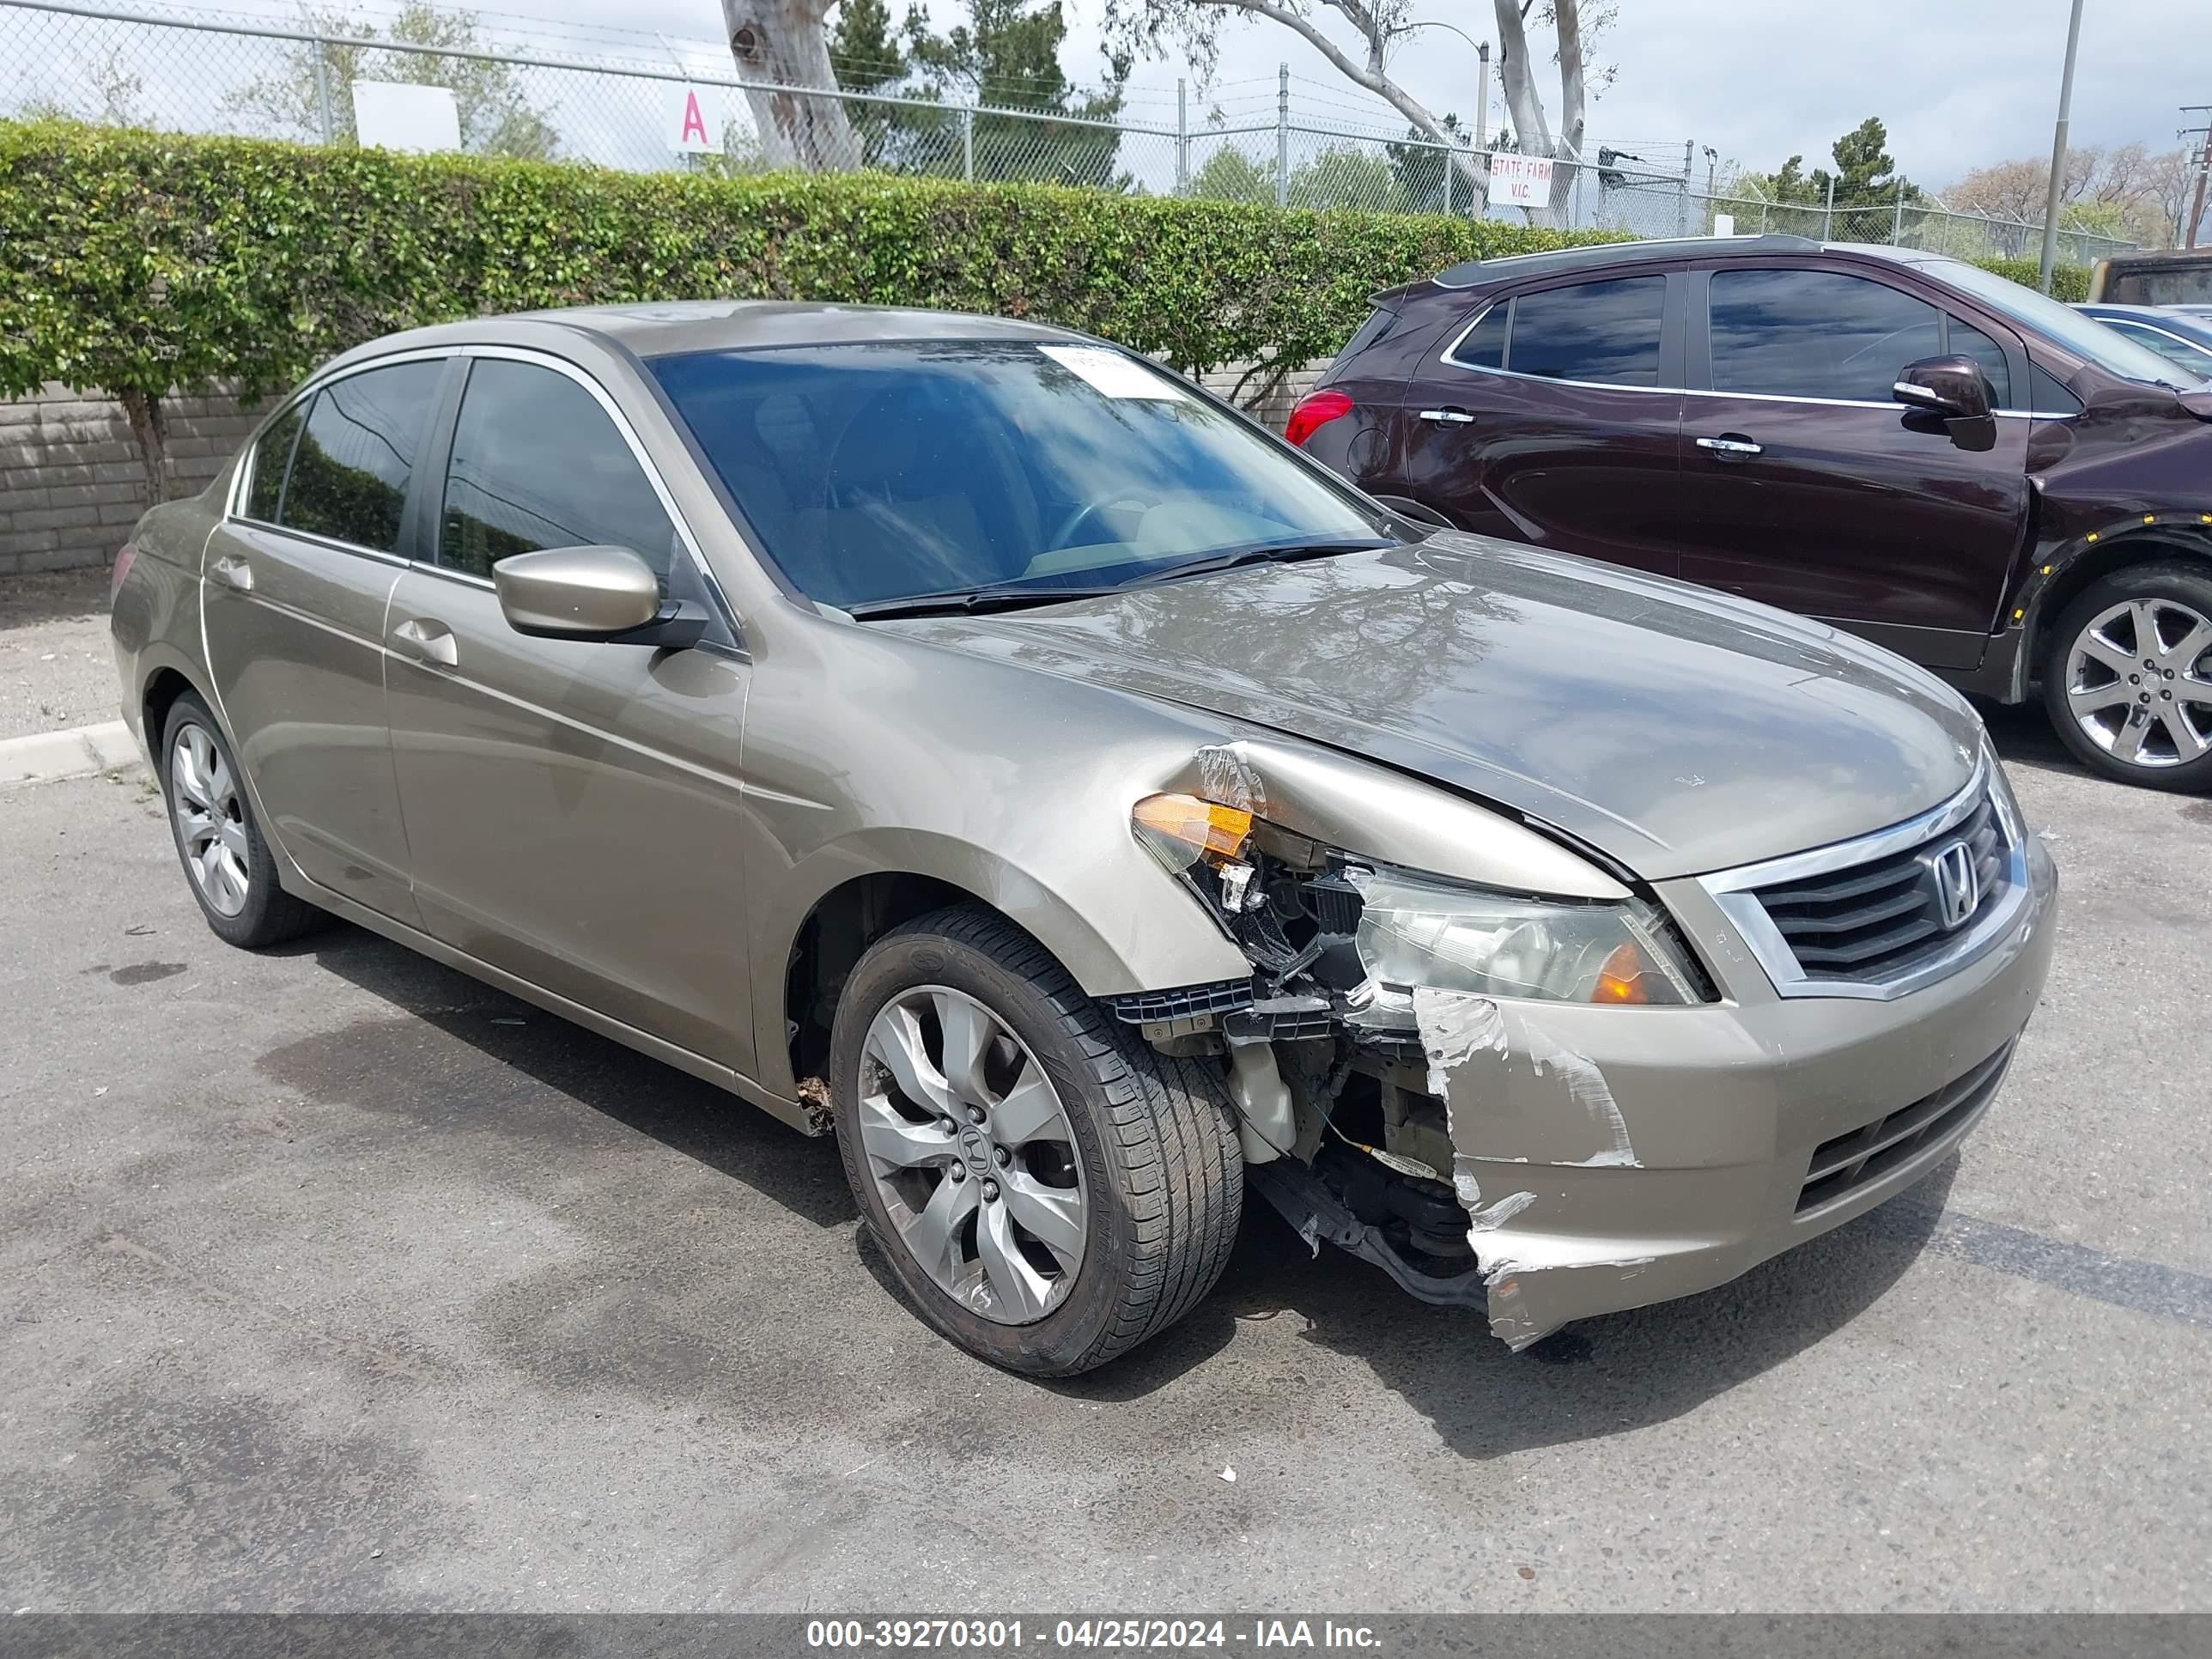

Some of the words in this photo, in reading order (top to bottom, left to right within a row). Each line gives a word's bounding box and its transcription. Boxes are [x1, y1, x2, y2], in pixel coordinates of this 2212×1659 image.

[682, 89, 708, 144] A
[1492, 159, 1522, 179] STATE
[1527, 161, 1552, 181] FARM
